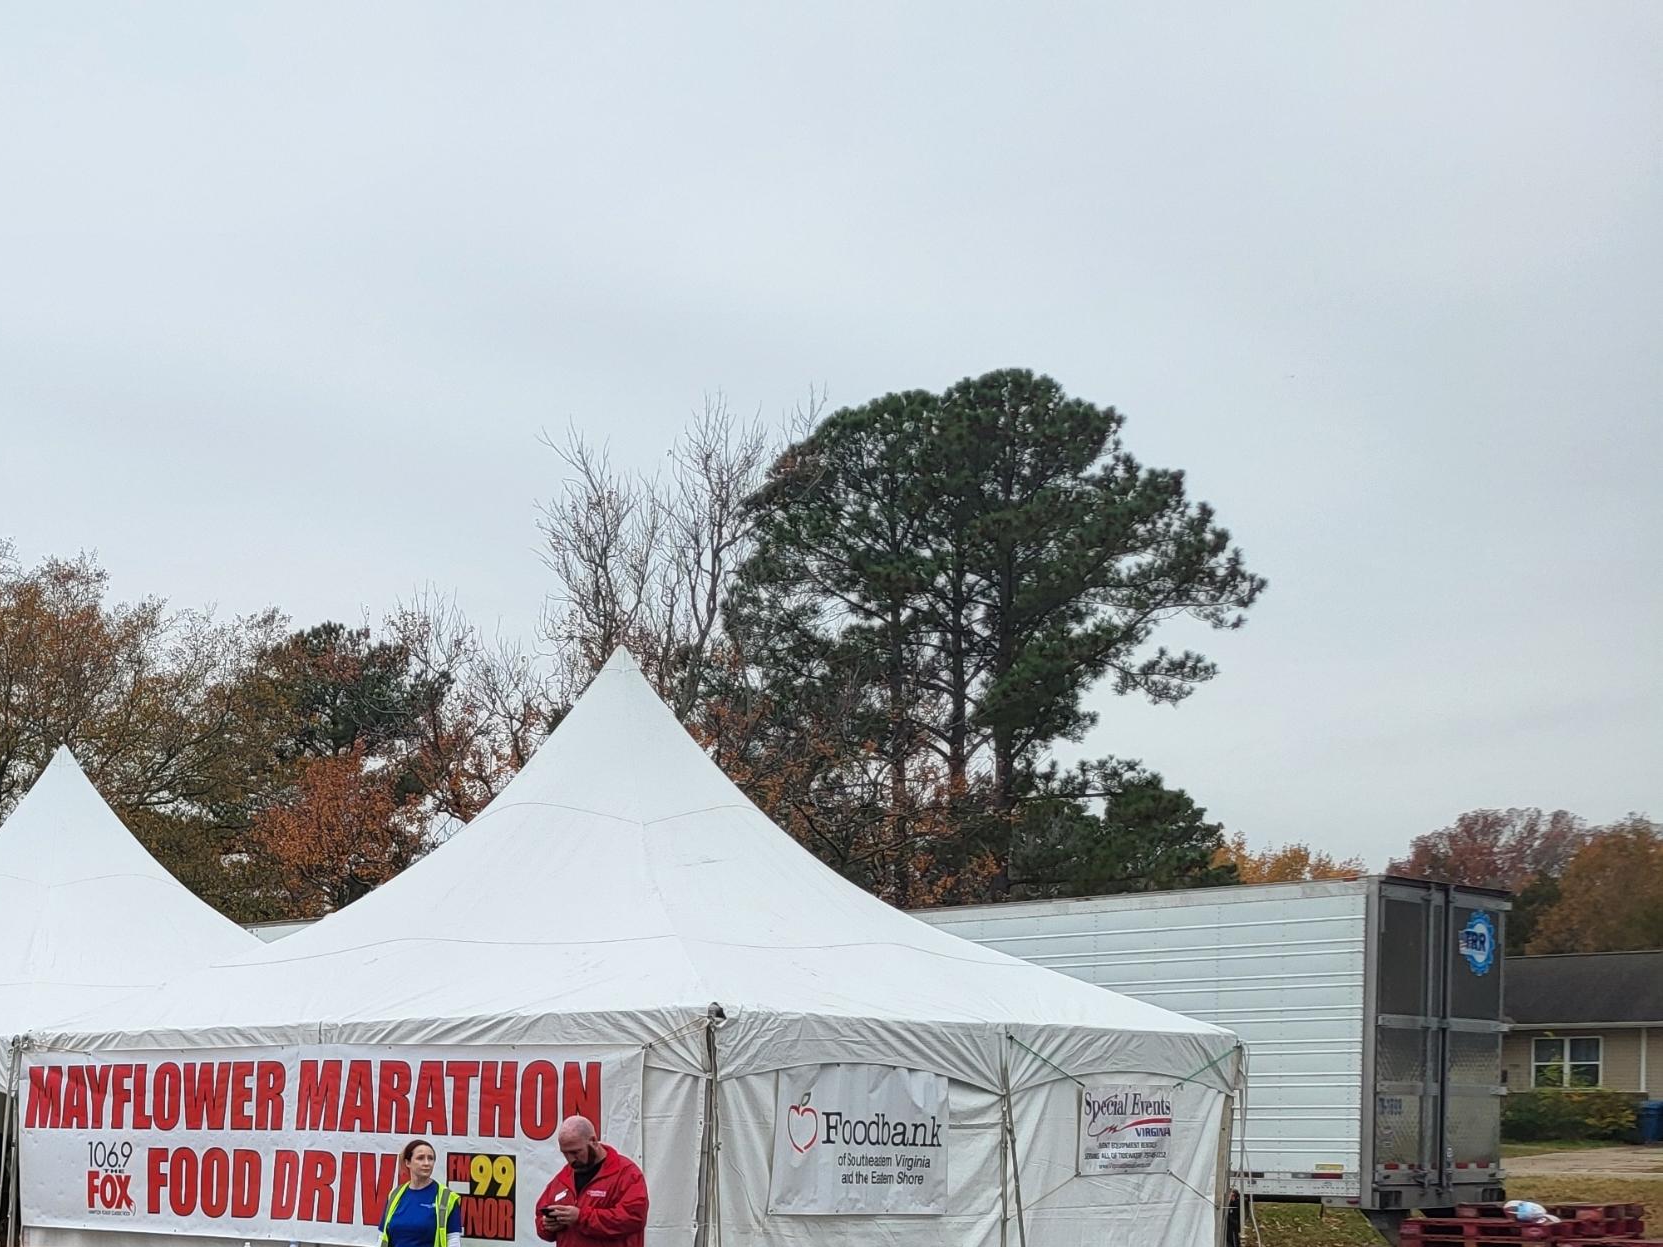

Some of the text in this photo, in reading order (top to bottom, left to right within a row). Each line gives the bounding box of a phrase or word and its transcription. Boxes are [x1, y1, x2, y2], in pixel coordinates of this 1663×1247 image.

[25, 1060, 602, 1141] MAYFLOWER MARATHON
[1084, 1092, 1171, 1122] Special Events
[822, 1112, 943, 1148] Foodbank
[88, 1141, 133, 1168] 106.9
[838, 1153, 846, 1167] of
[895, 1154, 931, 1171] Virginia
[88, 1171, 136, 1212] FOX
[147, 1147, 410, 1227] FOOD DRIV
[447, 1154, 515, 1197] FM 99
[855, 1171, 869, 1185] the
[896, 1171, 924, 1185] Shore
